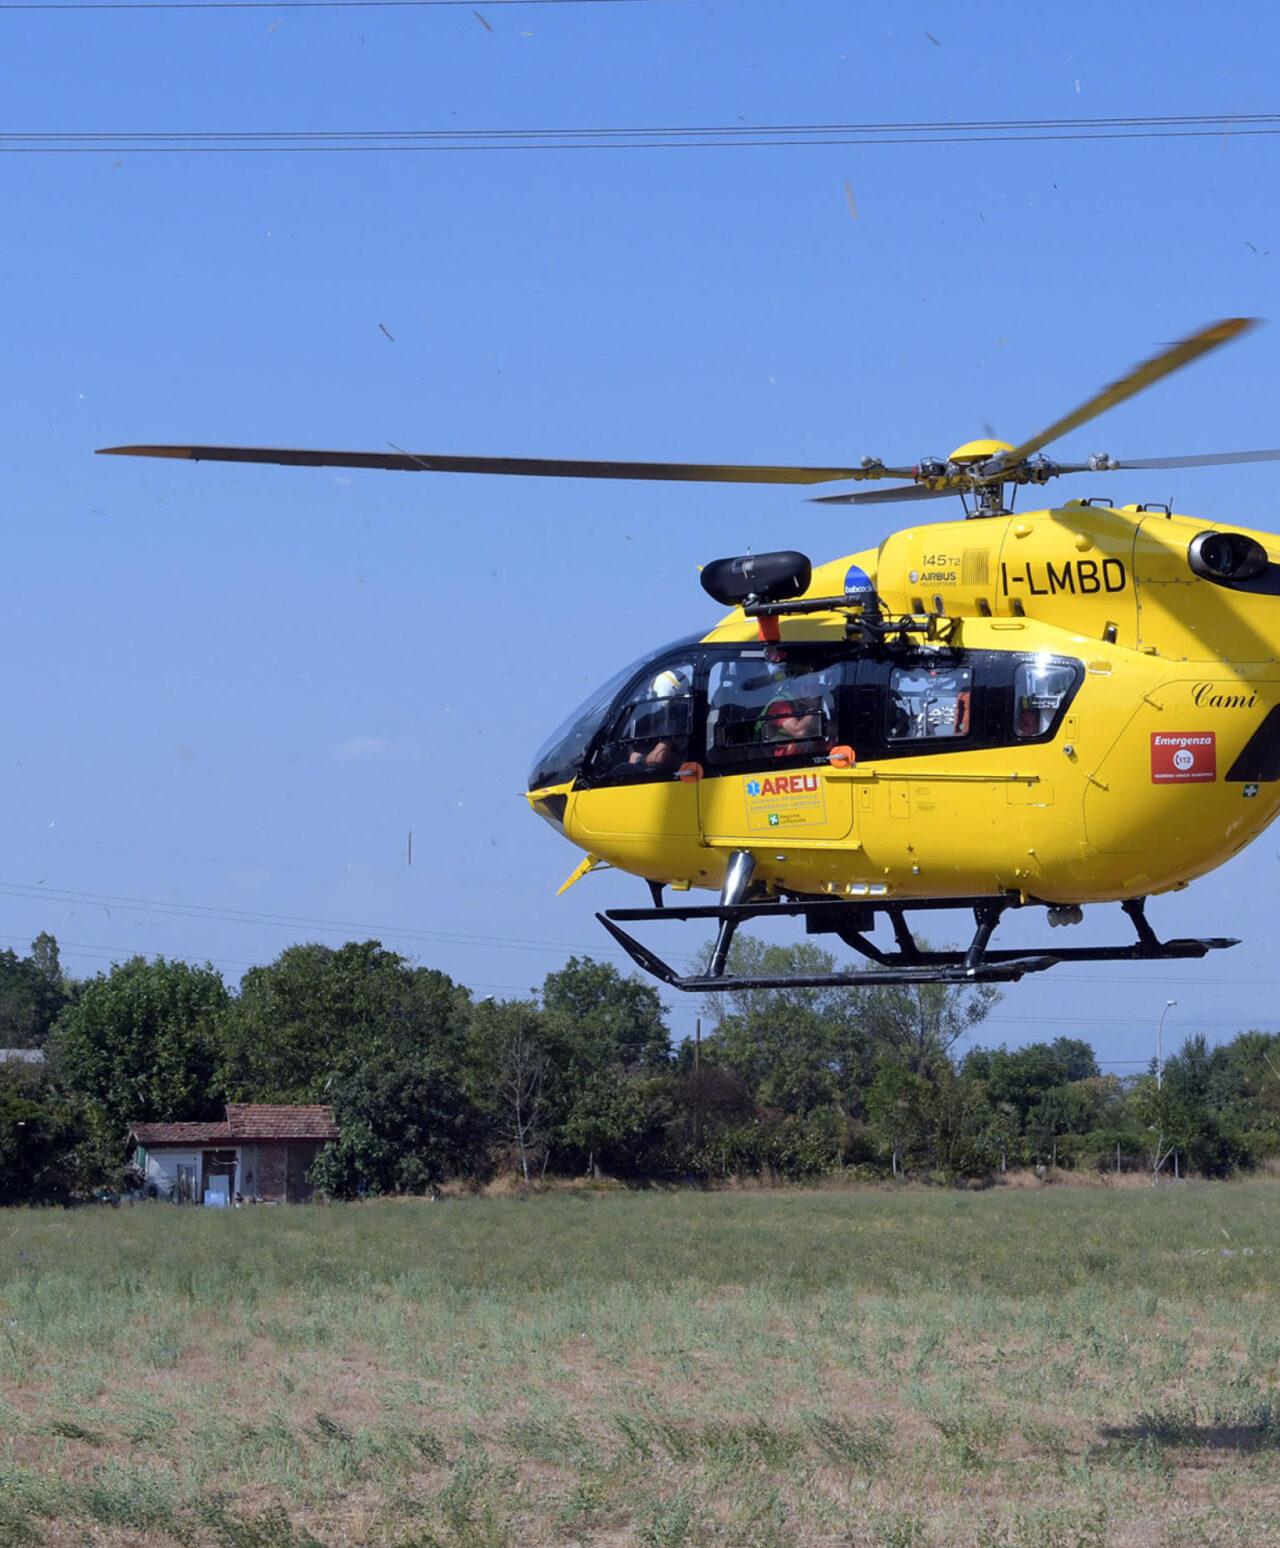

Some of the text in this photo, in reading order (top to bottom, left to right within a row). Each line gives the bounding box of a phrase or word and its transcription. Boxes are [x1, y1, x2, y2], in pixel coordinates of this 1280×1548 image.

[920, 572, 957, 582] AIRBUS
[1001, 557, 1127, 597] I-LMBD
[1191, 682, 1260, 709] Cami
[1154, 736, 1212, 748] Emergenza
[761, 773, 818, 796] AREU
